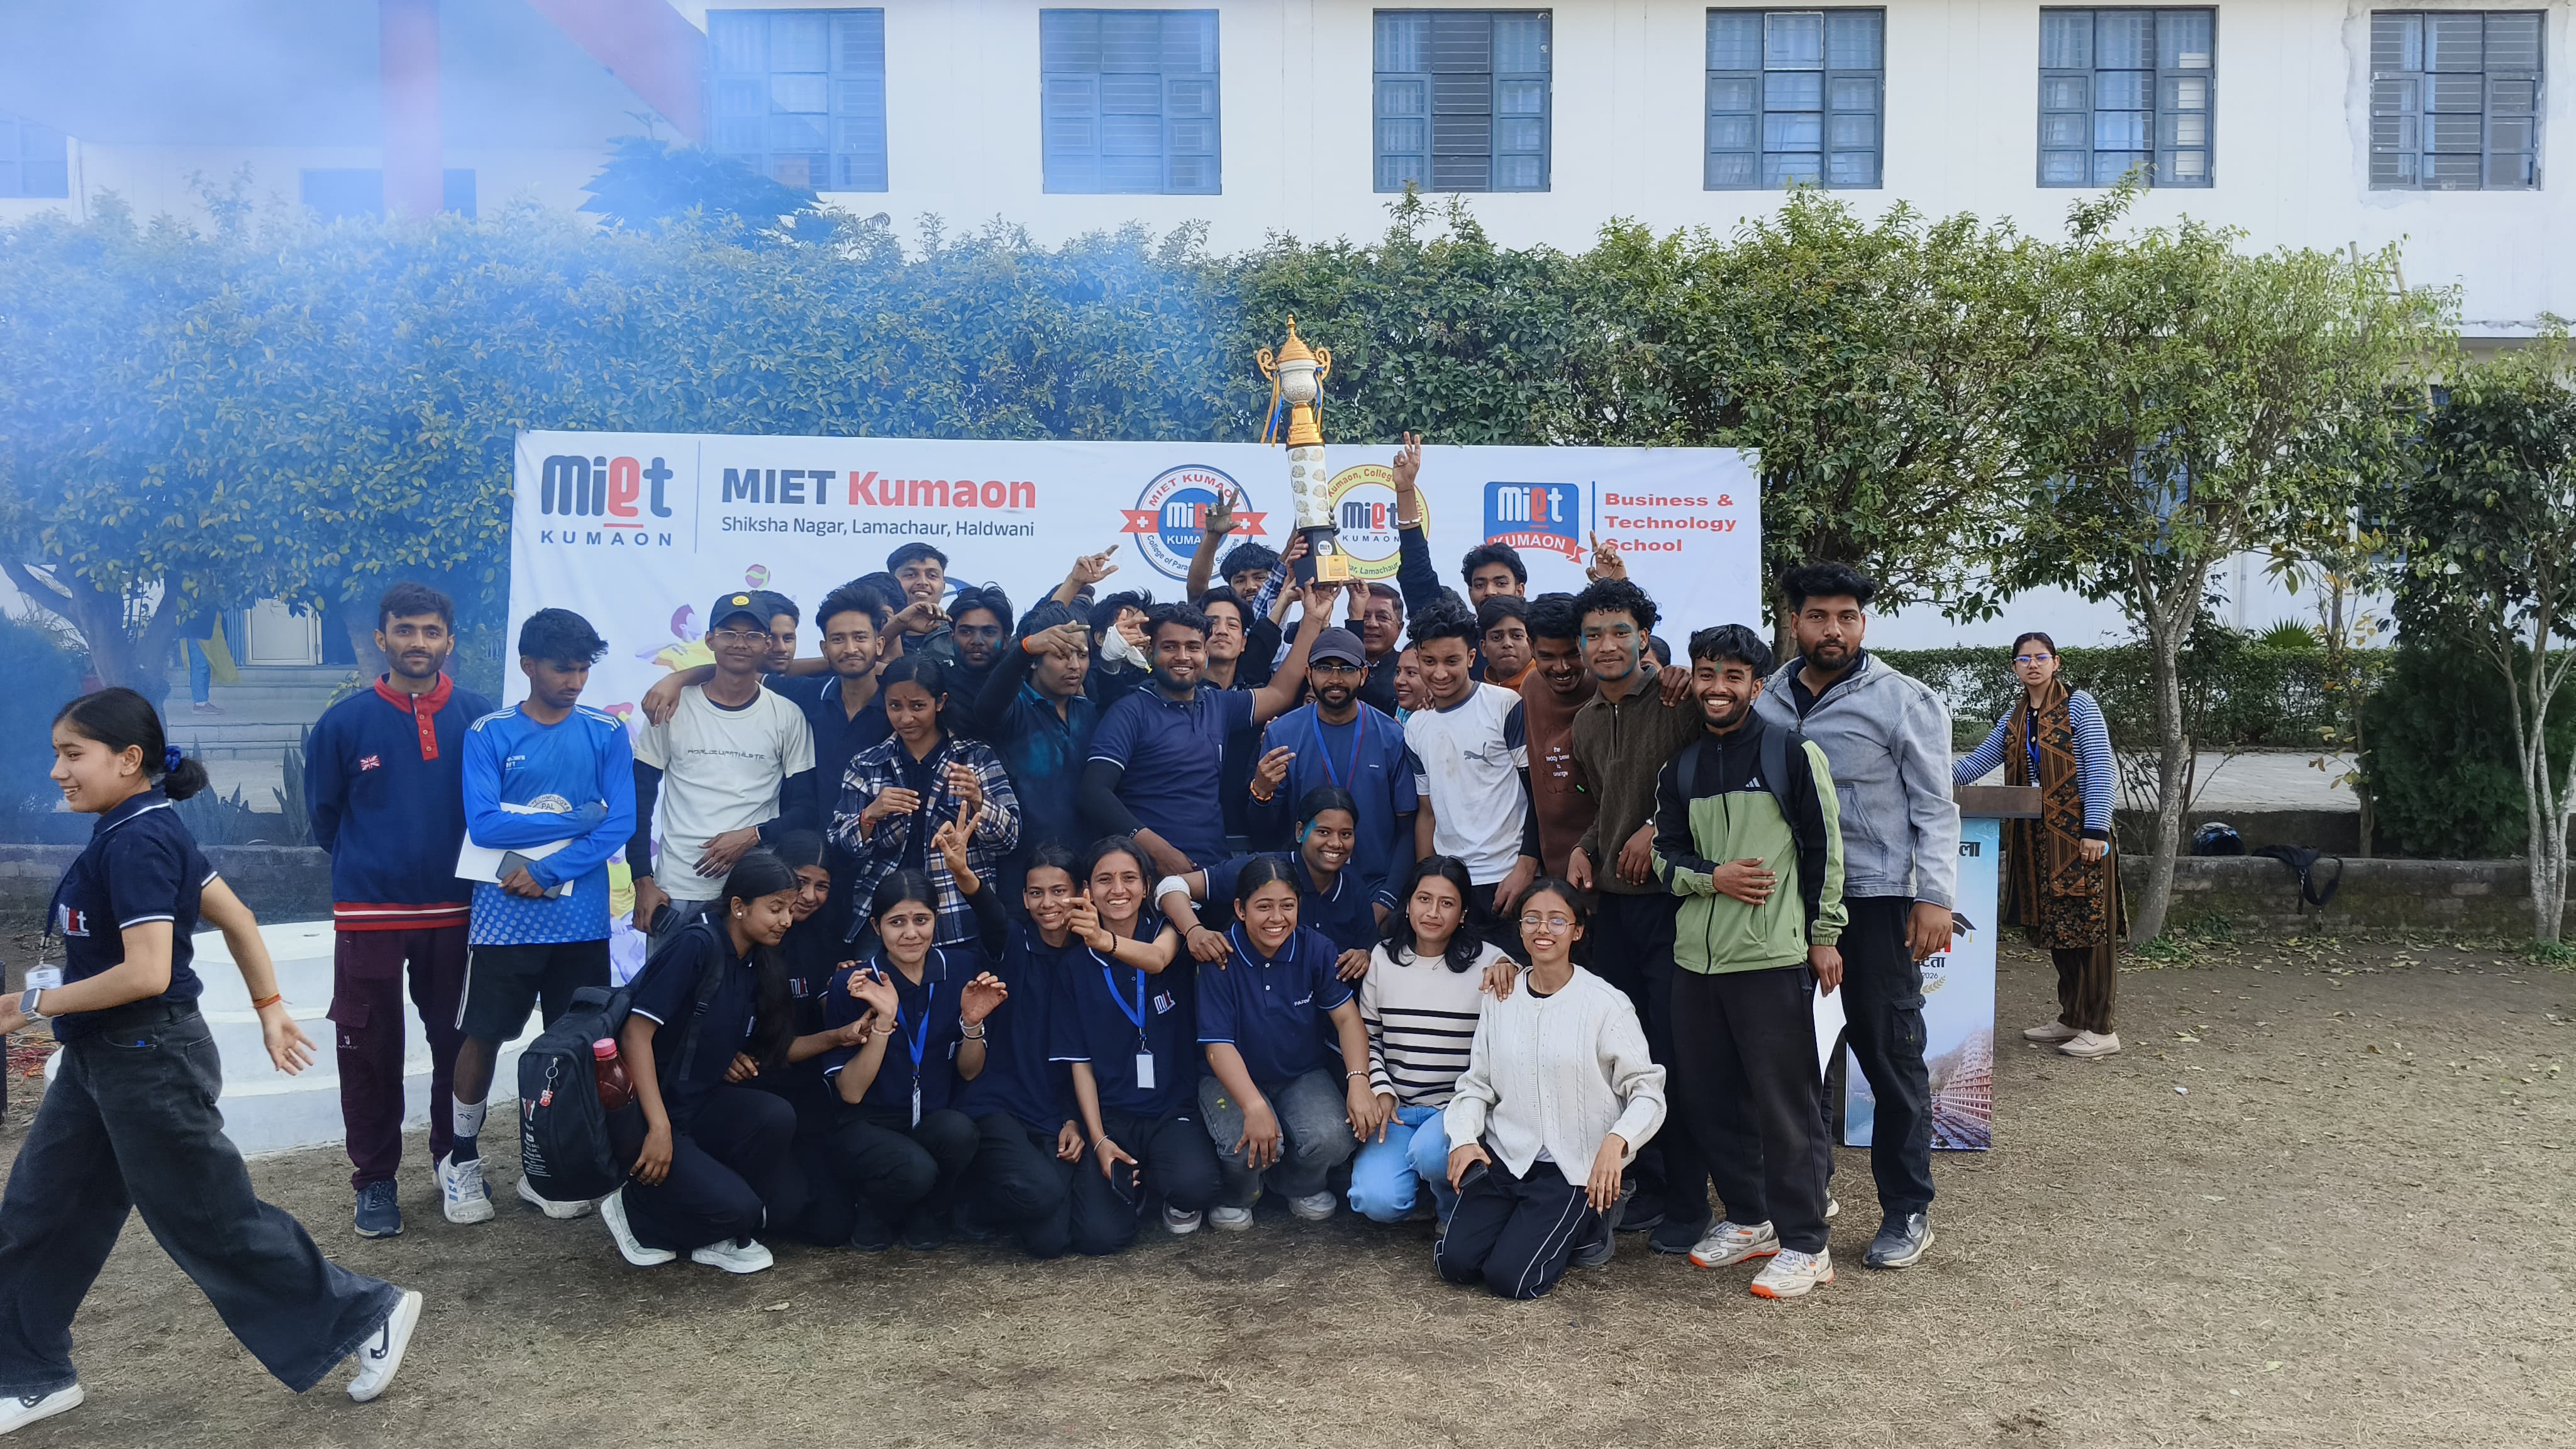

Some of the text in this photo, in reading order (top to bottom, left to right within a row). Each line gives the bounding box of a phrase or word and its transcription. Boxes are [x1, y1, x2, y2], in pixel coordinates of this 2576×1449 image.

[1363, 469, 1392, 482] Colleg
[722, 469, 1036, 508] MIET Kumaon
[1149, 478, 1177, 507] MIET
[1605, 492, 1734, 506] Business &
[1167, 502, 1206, 528] mie
[1604, 516, 1736, 532] Technology
[722, 516, 1034, 537] Shiksha Nagar, Lamachaur, Haldwani
[541, 530, 672, 547] KUMAON
[1147, 535, 1165, 559] College
[1605, 538, 1682, 552] School
